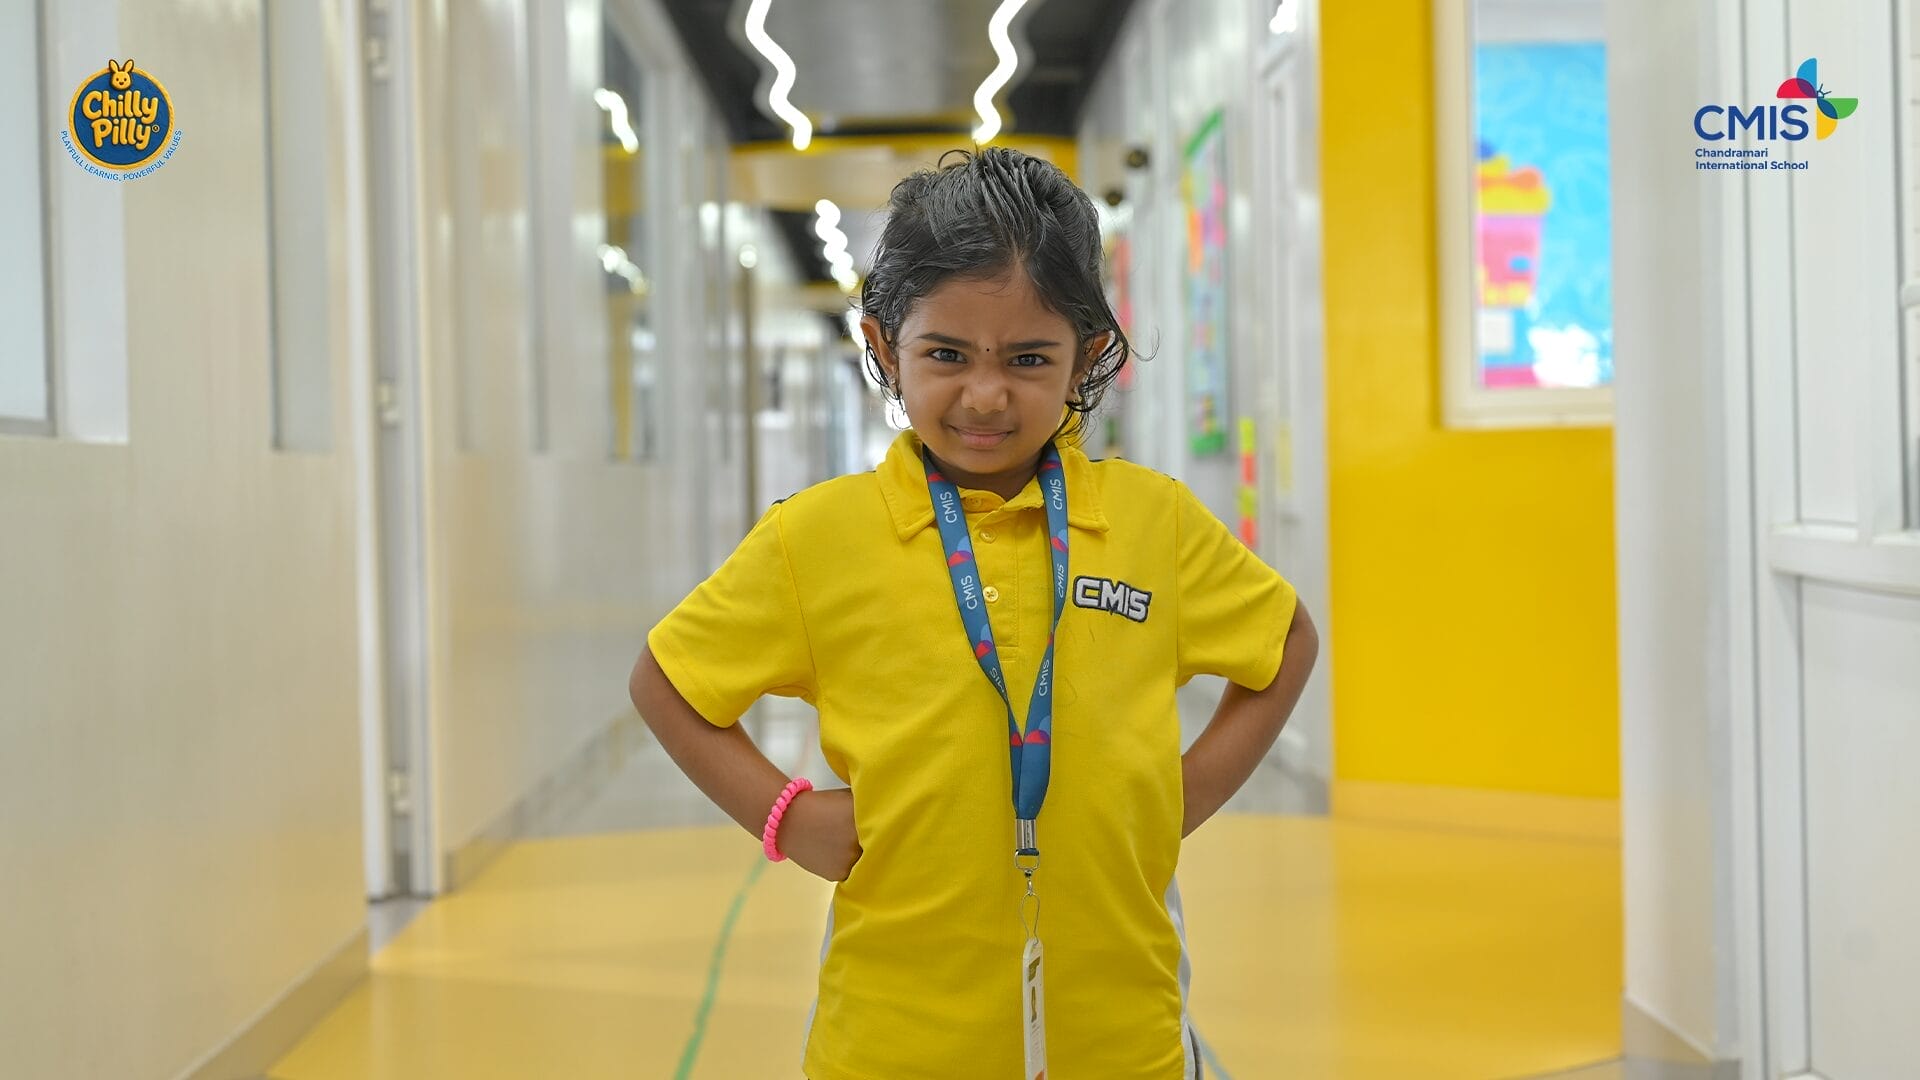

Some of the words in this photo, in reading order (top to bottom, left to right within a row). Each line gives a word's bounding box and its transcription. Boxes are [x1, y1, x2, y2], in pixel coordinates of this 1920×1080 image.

[939, 491, 957, 524] CMIS
[1050, 478, 1063, 511] CMIS
[960, 575, 978, 610] CMIS
[1056, 563, 1065, 599] CMIS
[1074, 576, 1151, 622] CMIS
[1038, 659, 1050, 697] CMIS
